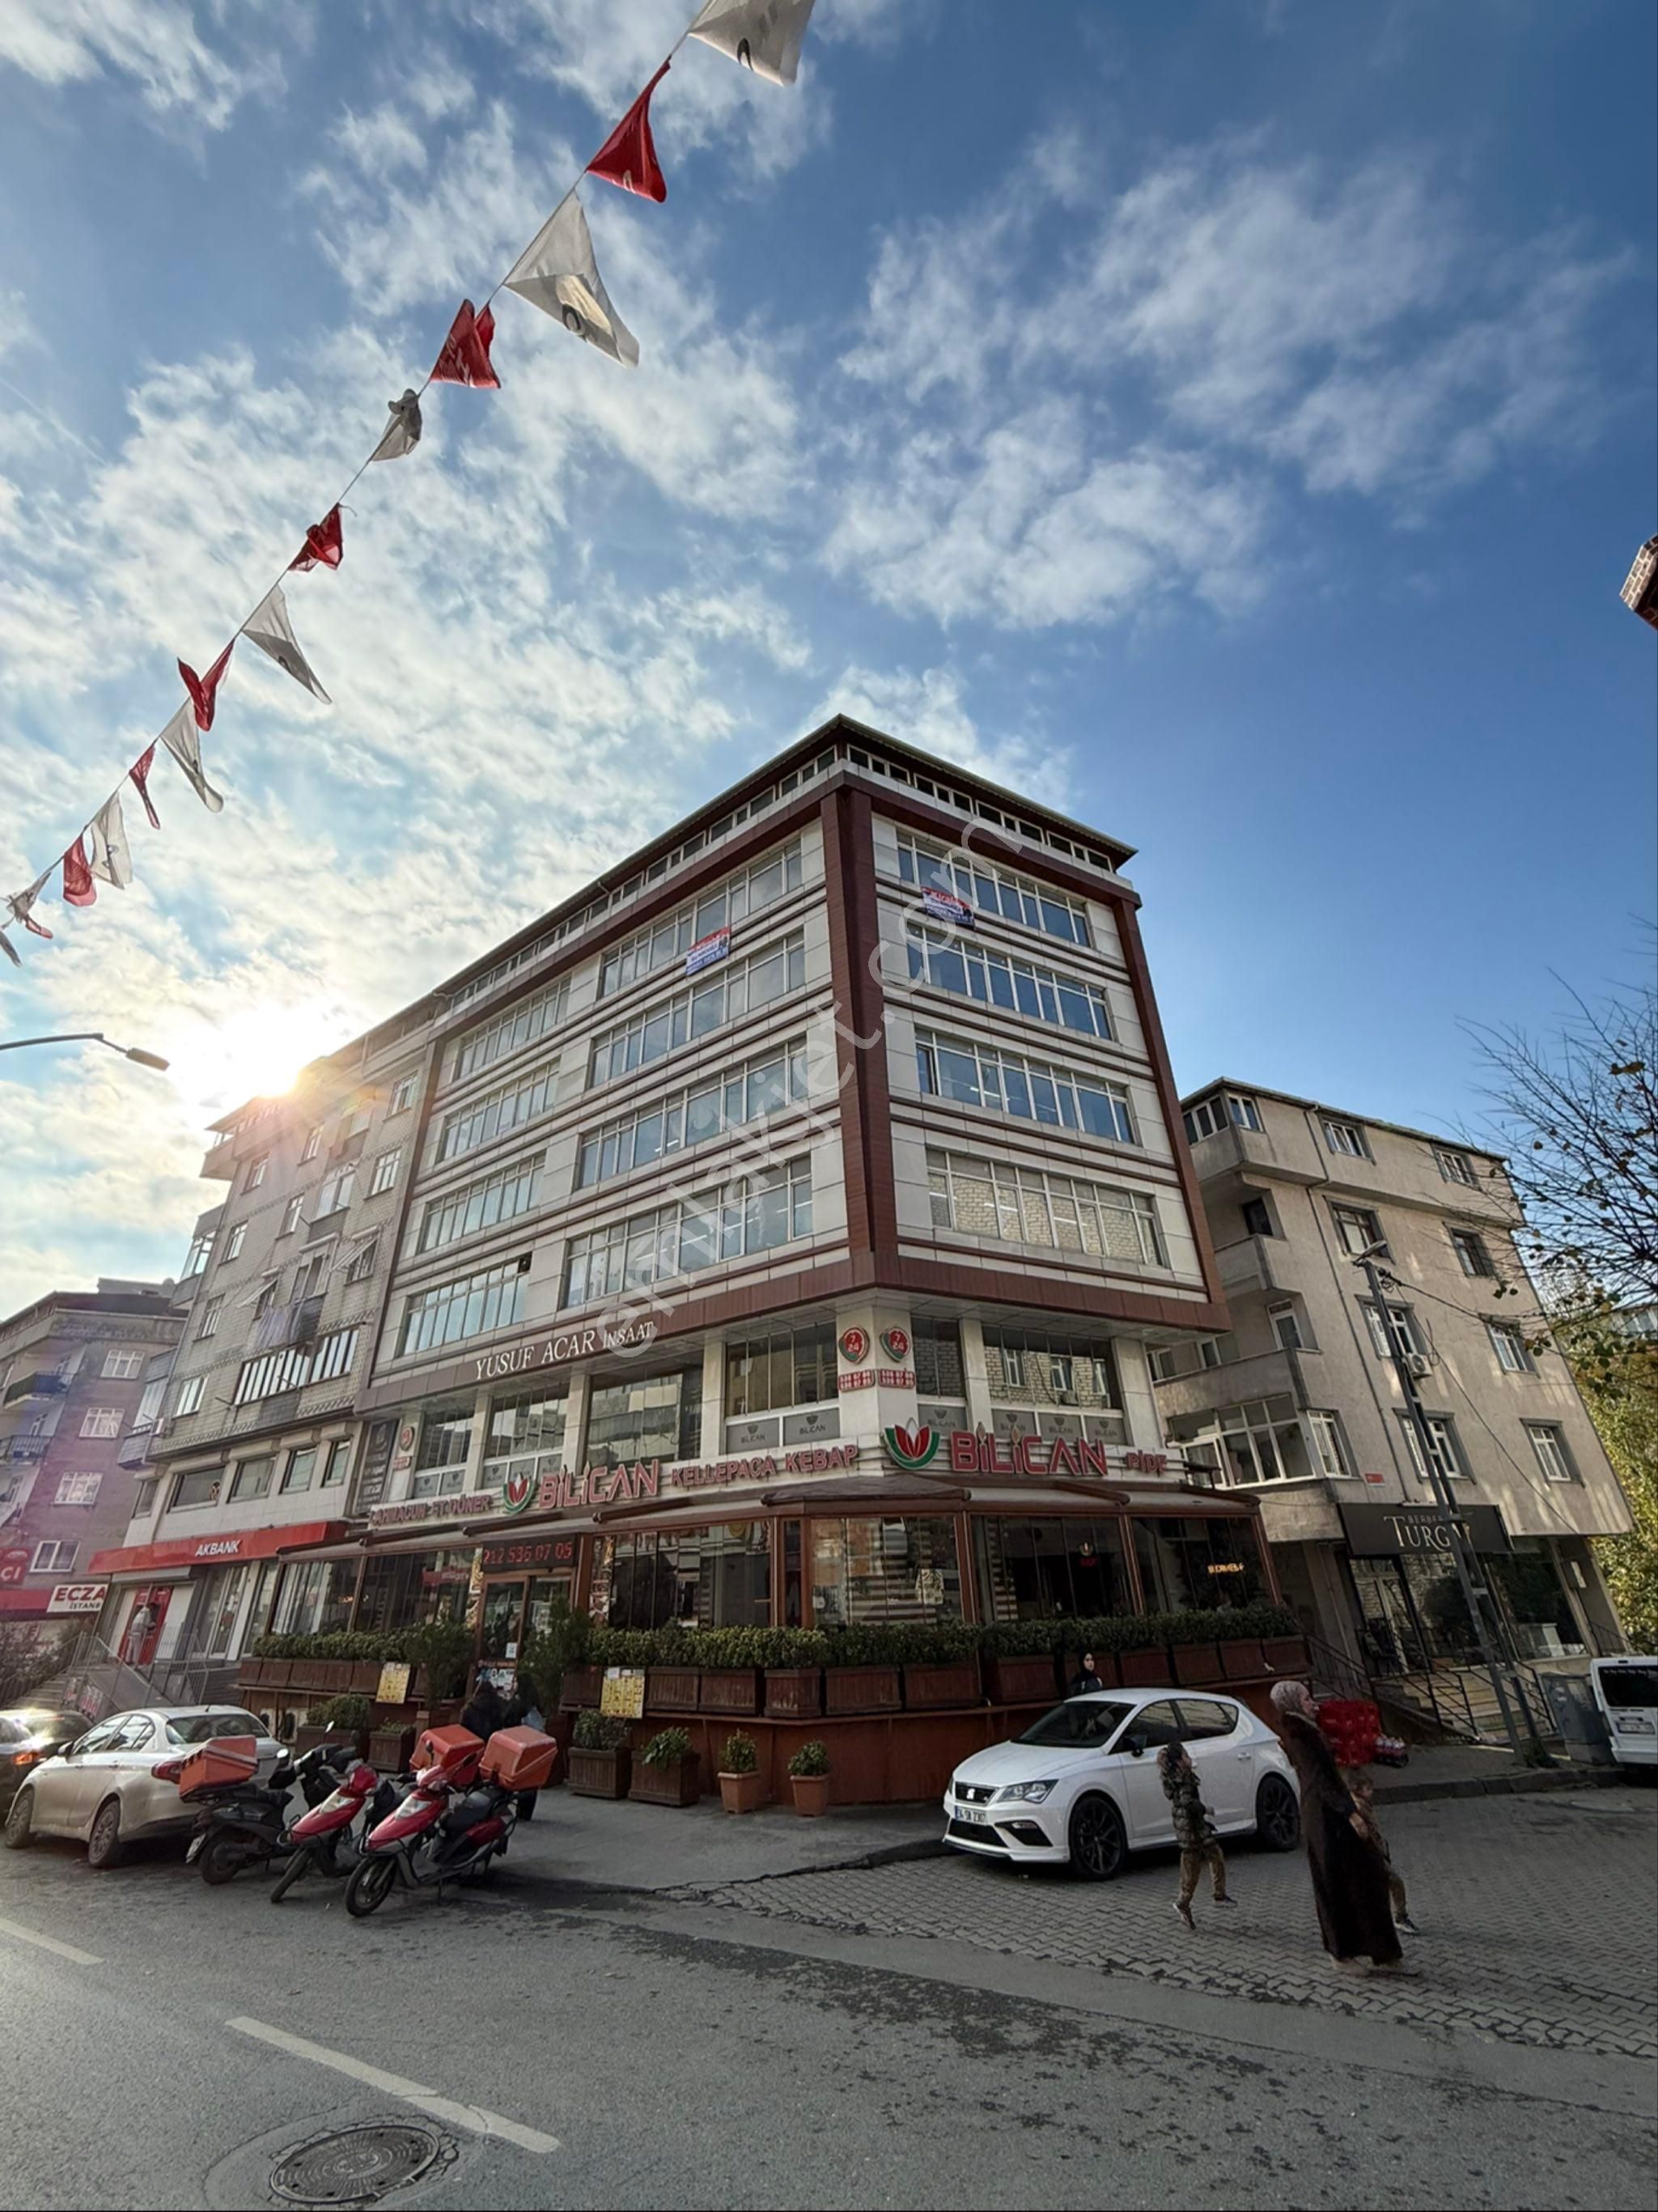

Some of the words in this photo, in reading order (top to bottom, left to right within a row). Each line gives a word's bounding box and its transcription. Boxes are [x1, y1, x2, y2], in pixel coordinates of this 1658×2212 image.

[475, 1347, 535, 1380] YUSUF
[541, 1330, 596, 1364] ACAR
[784, 1444, 859, 1473] KEBAP
[195, 1540, 240, 1556] AKBANK
